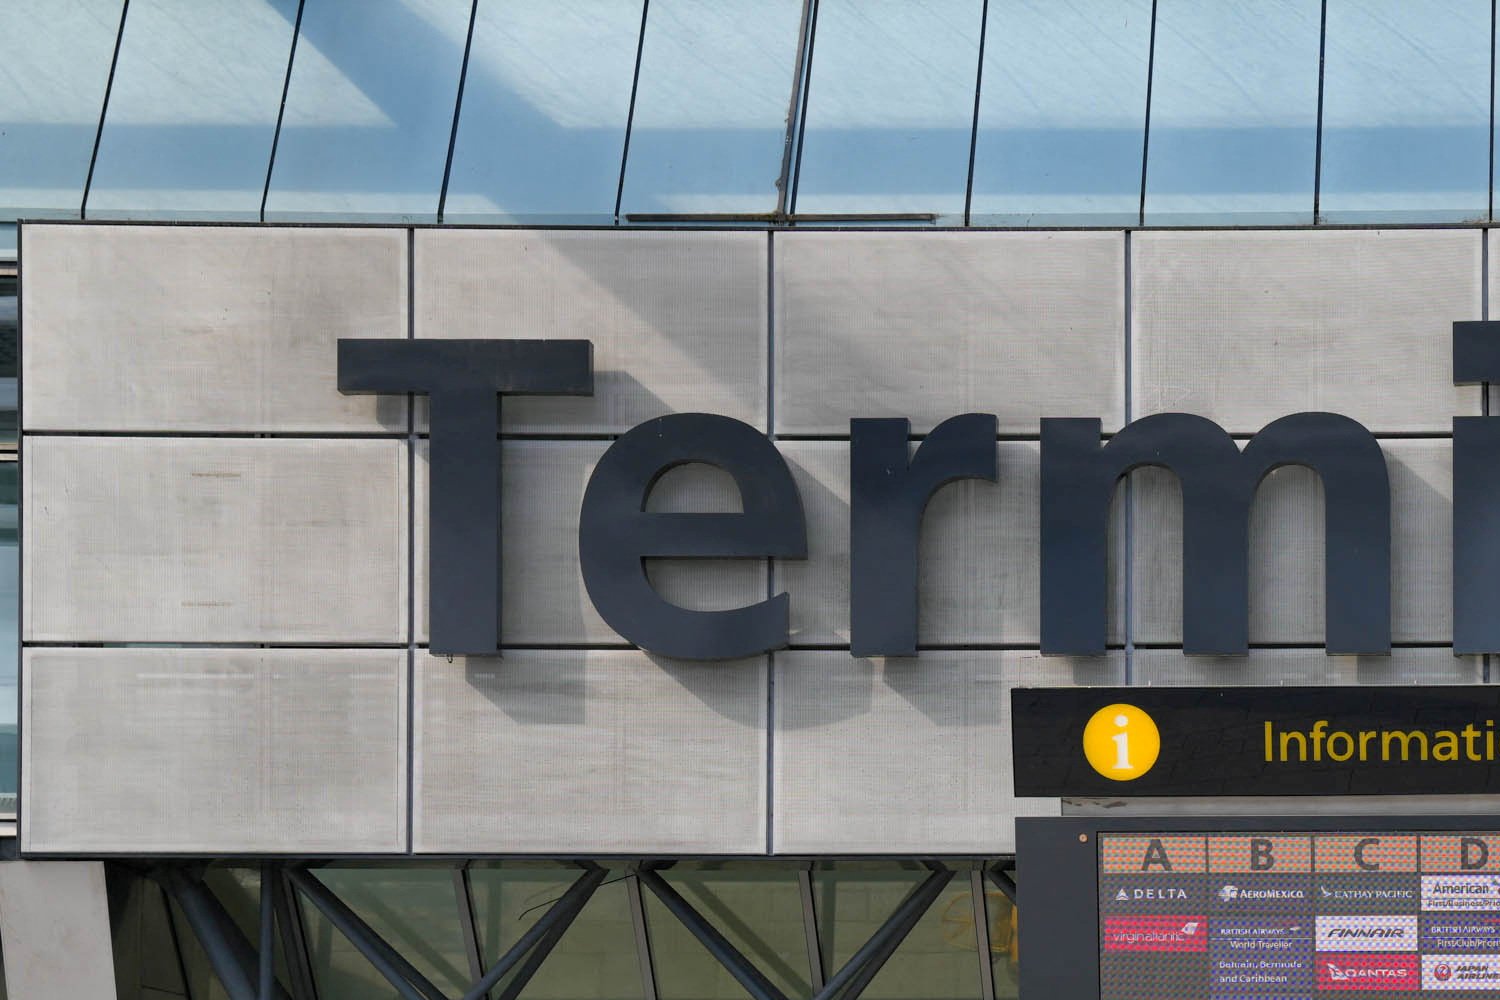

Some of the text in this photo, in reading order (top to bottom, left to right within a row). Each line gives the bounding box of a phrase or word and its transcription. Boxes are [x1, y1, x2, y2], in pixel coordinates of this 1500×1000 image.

[1141, 839, 1173, 871] A
[1250, 838, 1275, 870] B
[1354, 838, 1380, 870] C
[1461, 838, 1489, 870] D
[1134, 888, 1188, 899] DELTA
[1433, 883, 1489, 894] American
[1334, 890, 1413, 898] CATHAY PACIFIC
[1328, 928, 1405, 938] FINNAIR
[1230, 940, 1293, 949] World Traveller
[1260, 960, 1302, 968] Bermuda
[1455, 965, 1489, 973] JAPAN
[1220, 973, 1288, 983] and Caribbean
